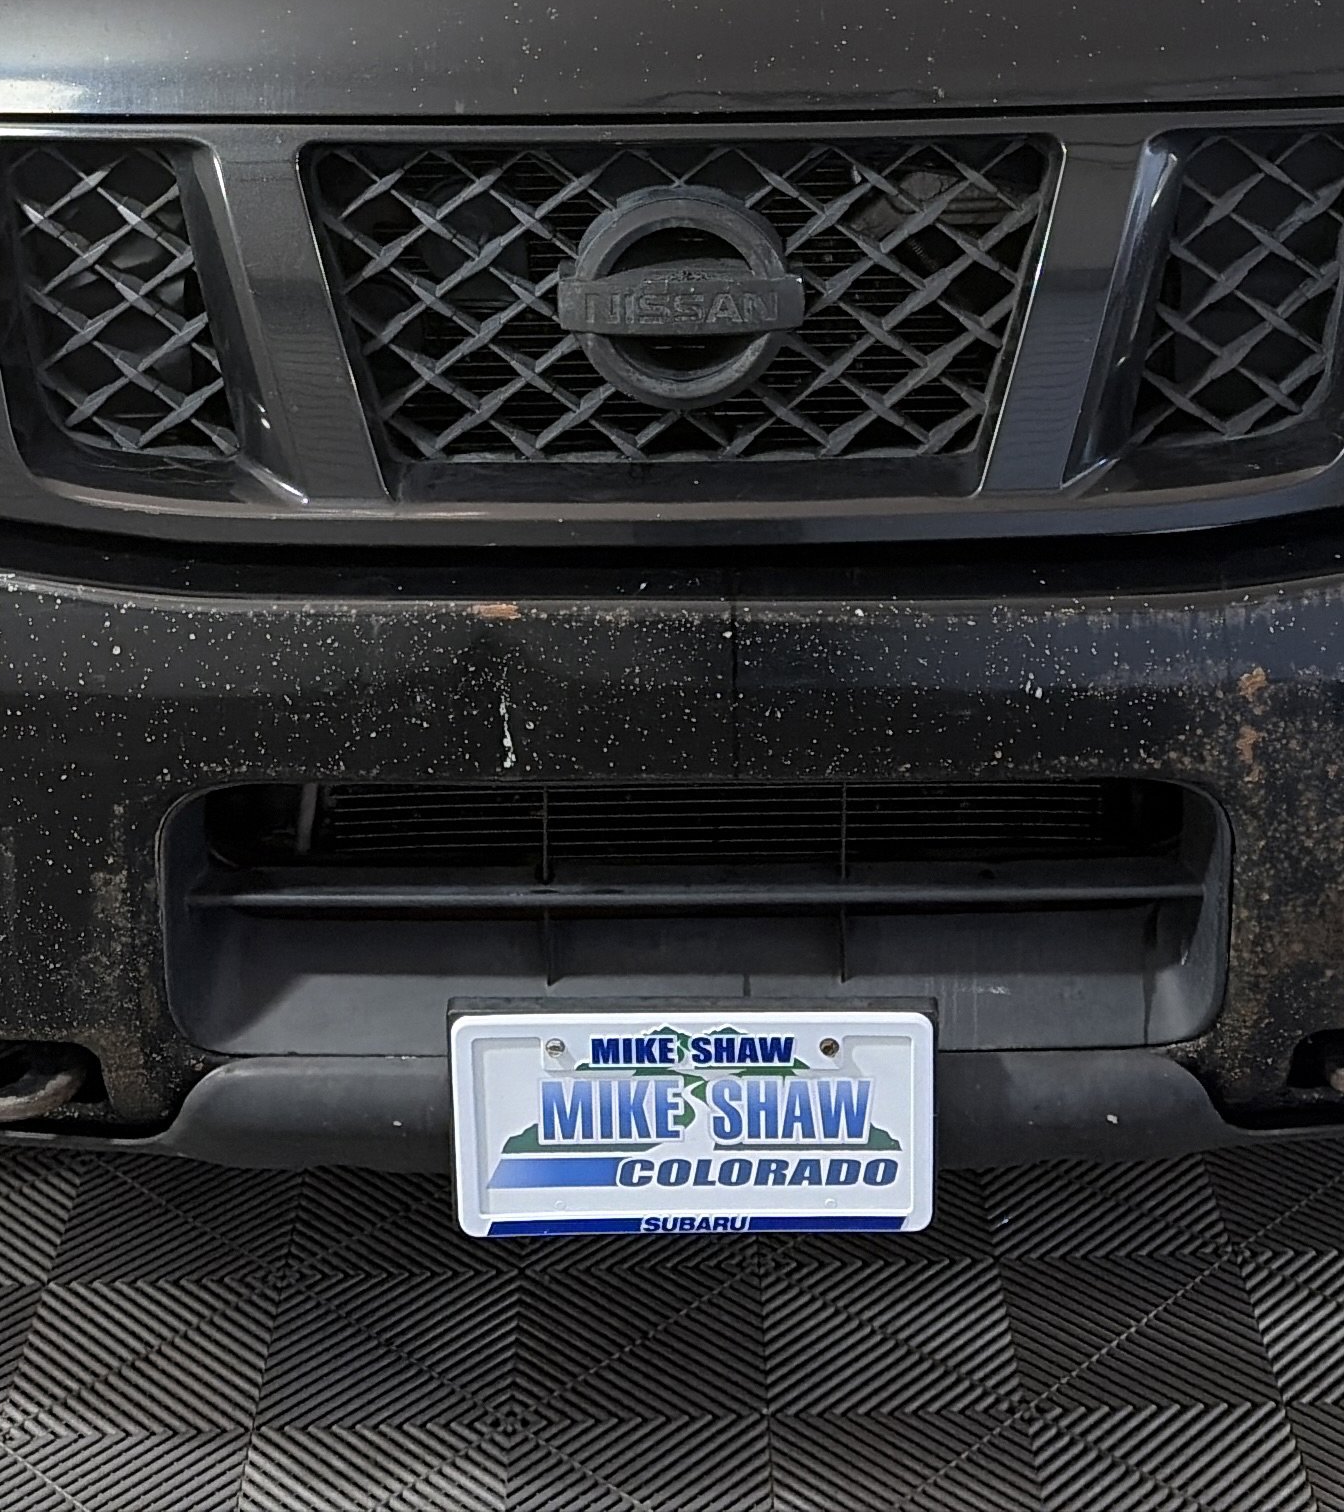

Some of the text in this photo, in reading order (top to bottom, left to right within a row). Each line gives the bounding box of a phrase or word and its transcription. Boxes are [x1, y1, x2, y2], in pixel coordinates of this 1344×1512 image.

[583, 291, 779, 325] NISSAN
[591, 1037, 794, 1064] MIKE SHAW
[542, 1079, 872, 1140] MIKE SHAW
[620, 1158, 898, 1186] COLORADO
[643, 1216, 748, 1232] SUBARU
